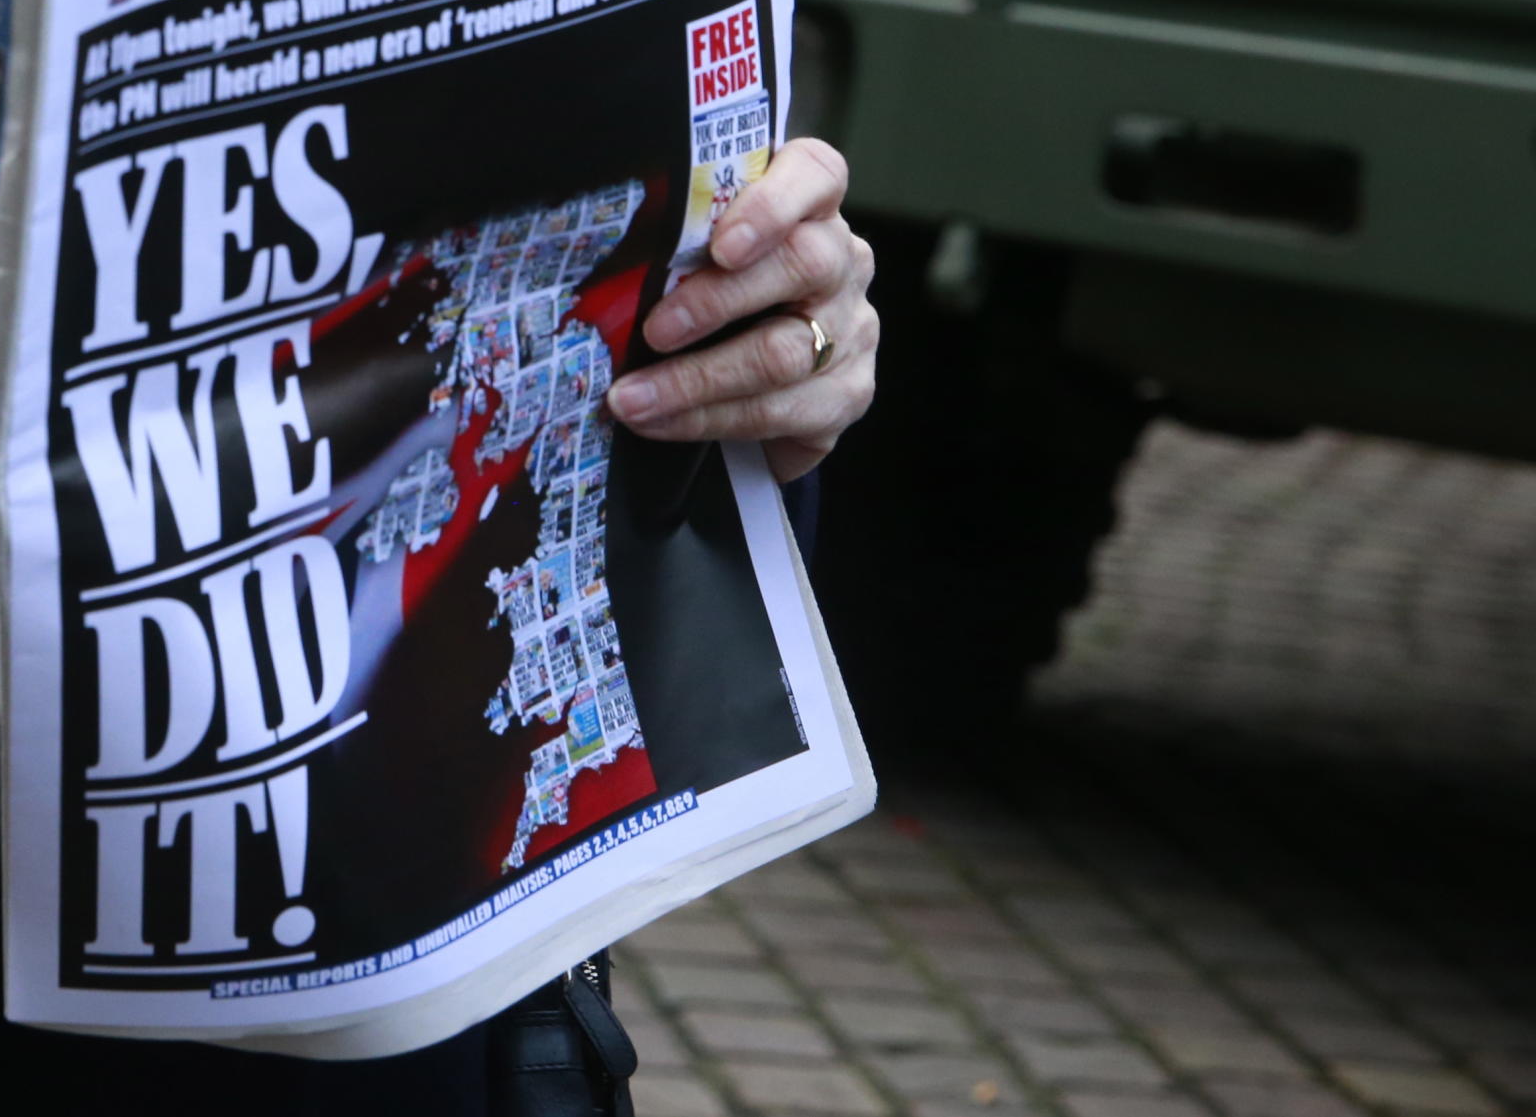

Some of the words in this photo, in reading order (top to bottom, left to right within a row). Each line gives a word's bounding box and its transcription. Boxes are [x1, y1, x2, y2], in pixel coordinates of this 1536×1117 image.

[78, 98, 117, 142] the
[119, 80, 157, 125] PM
[160, 66, 212, 113] will
[215, 46, 300, 101] herald
[303, 50, 320, 80] a
[323, 37, 377, 75] new
[380, 25, 423, 61] era
[425, 8, 453, 50] of
[84, 40, 109, 83] At
[165, 0, 260, 54] tonight,
[692, 7, 755, 69] FREE
[695, 52, 758, 106] INSIDE
[716, 117, 734, 138] GOT
[74, 104, 385, 353] YES,
[61, 318, 331, 575] WE
[84, 534, 351, 781] DID
[84, 764, 316, 957] IT!
[215, 975, 292, 998] SPECIAL
[296, 957, 377, 989] REPORTS
[380, 944, 414, 971] AND
[415, 900, 493, 957] UNRIVALLED
[493, 865, 554, 915] ANALYSIS:
[554, 841, 593, 878] PAGES
[592, 790, 694, 855] 2,3,4,5,6,7,8&9
